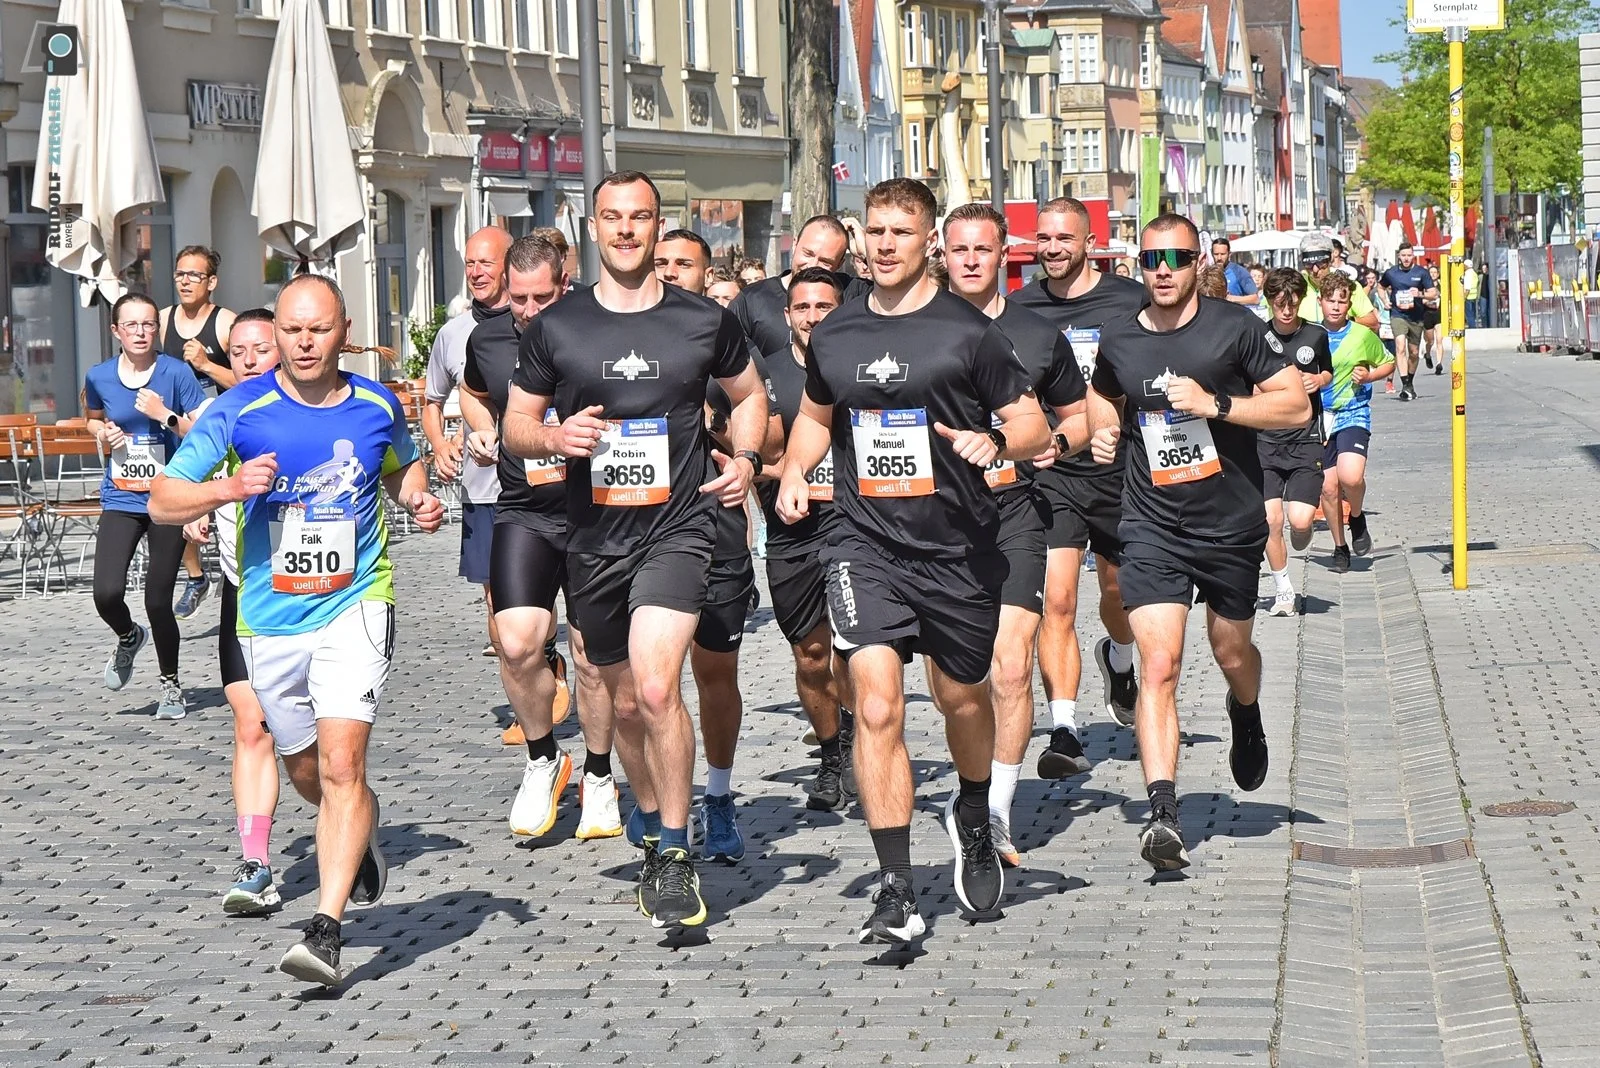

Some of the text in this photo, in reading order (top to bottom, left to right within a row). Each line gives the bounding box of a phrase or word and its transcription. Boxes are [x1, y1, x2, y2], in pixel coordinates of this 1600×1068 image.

[1434, 3, 1478, 13] Sternplatz
[873, 439, 905, 449] Manuel
[126, 453, 148, 462] Sophie
[612, 449, 646, 458] Robin
[1157, 443, 1204, 468] 3654
[121, 464, 155, 478] 3900
[867, 455, 917, 477] 3655
[295, 475, 336, 484] MAISEL'S
[603, 464, 655, 486] 3659
[1169, 466, 1202, 480] well fit
[292, 483, 337, 493] FunRun
[875, 480, 912, 493] well fit
[611, 489, 649, 502] well fit
[301, 534, 322, 545] Falk
[284, 551, 340, 574] 3510
[293, 576, 332, 590] well fit
